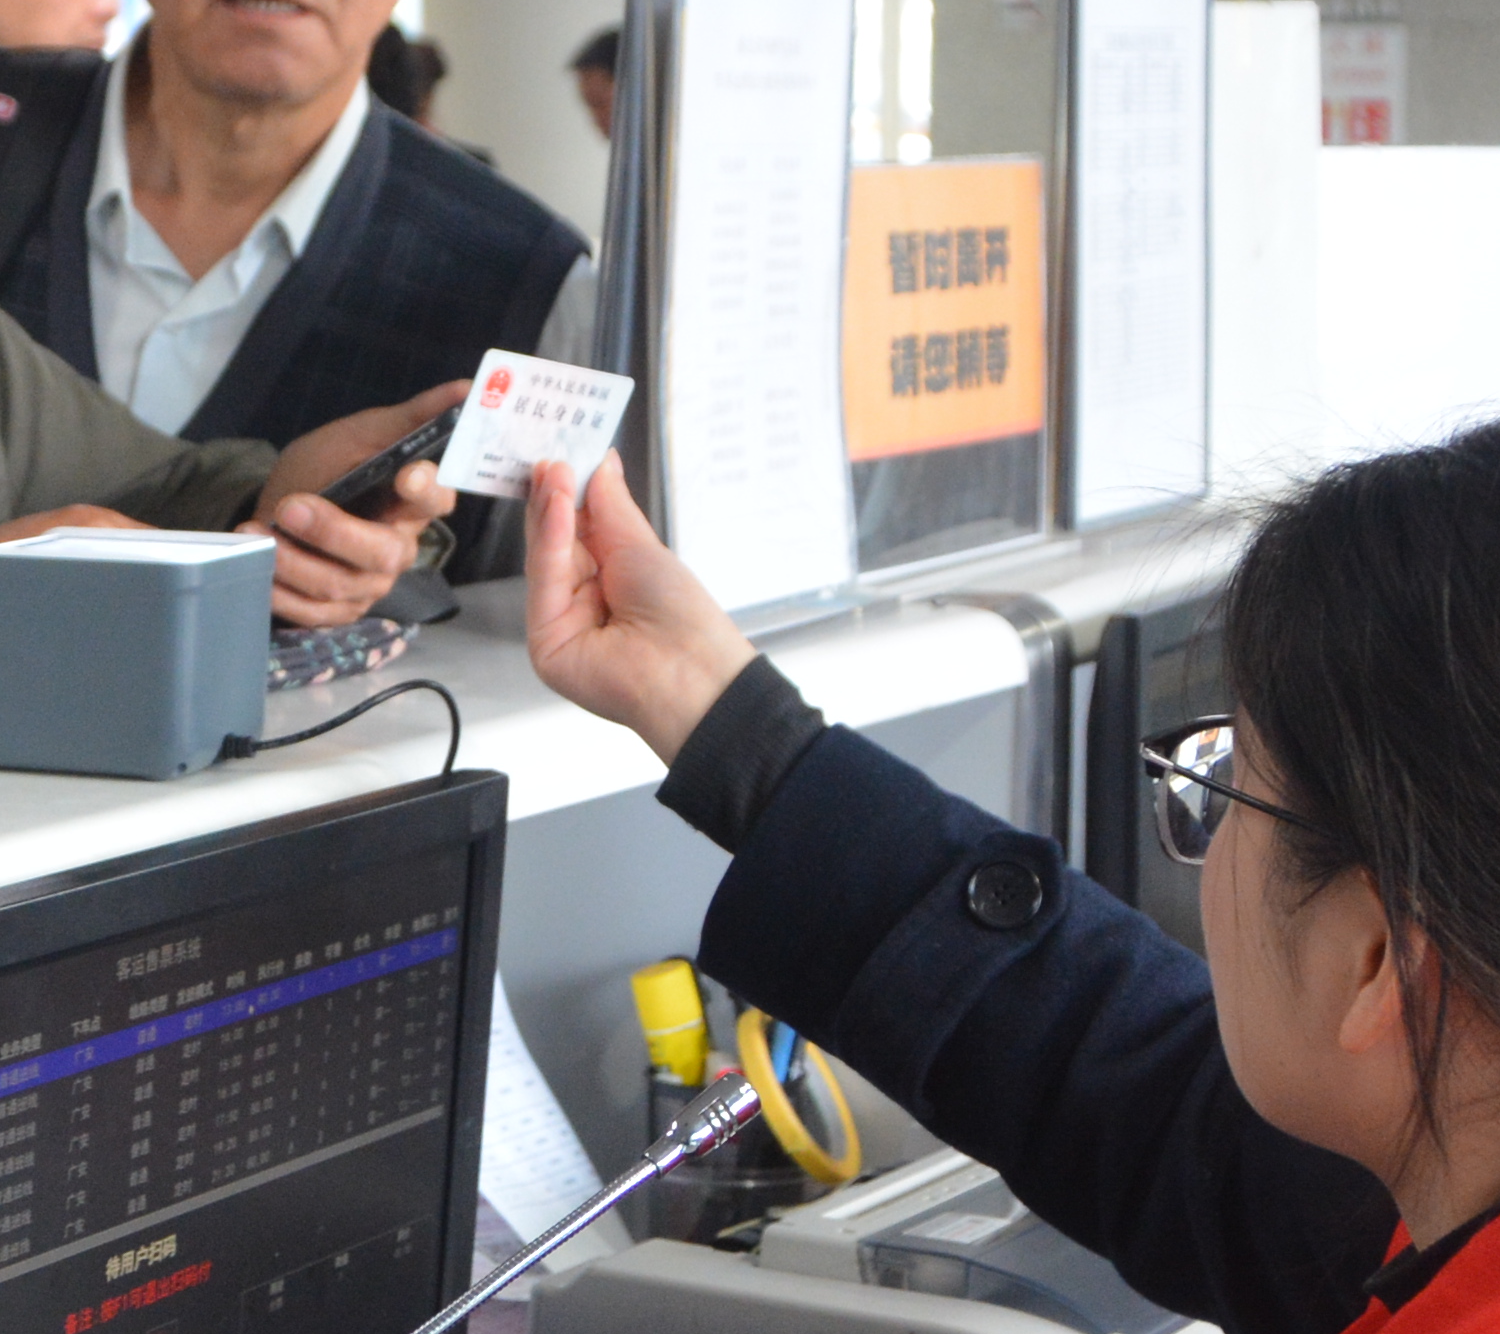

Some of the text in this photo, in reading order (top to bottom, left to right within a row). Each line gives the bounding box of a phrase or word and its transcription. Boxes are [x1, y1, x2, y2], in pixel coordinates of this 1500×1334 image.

[531, 373, 611, 400] 中华人民共和国
[514, 395, 605, 428] 居民身份证
[104, 1233, 177, 1283] 待用户扫码
